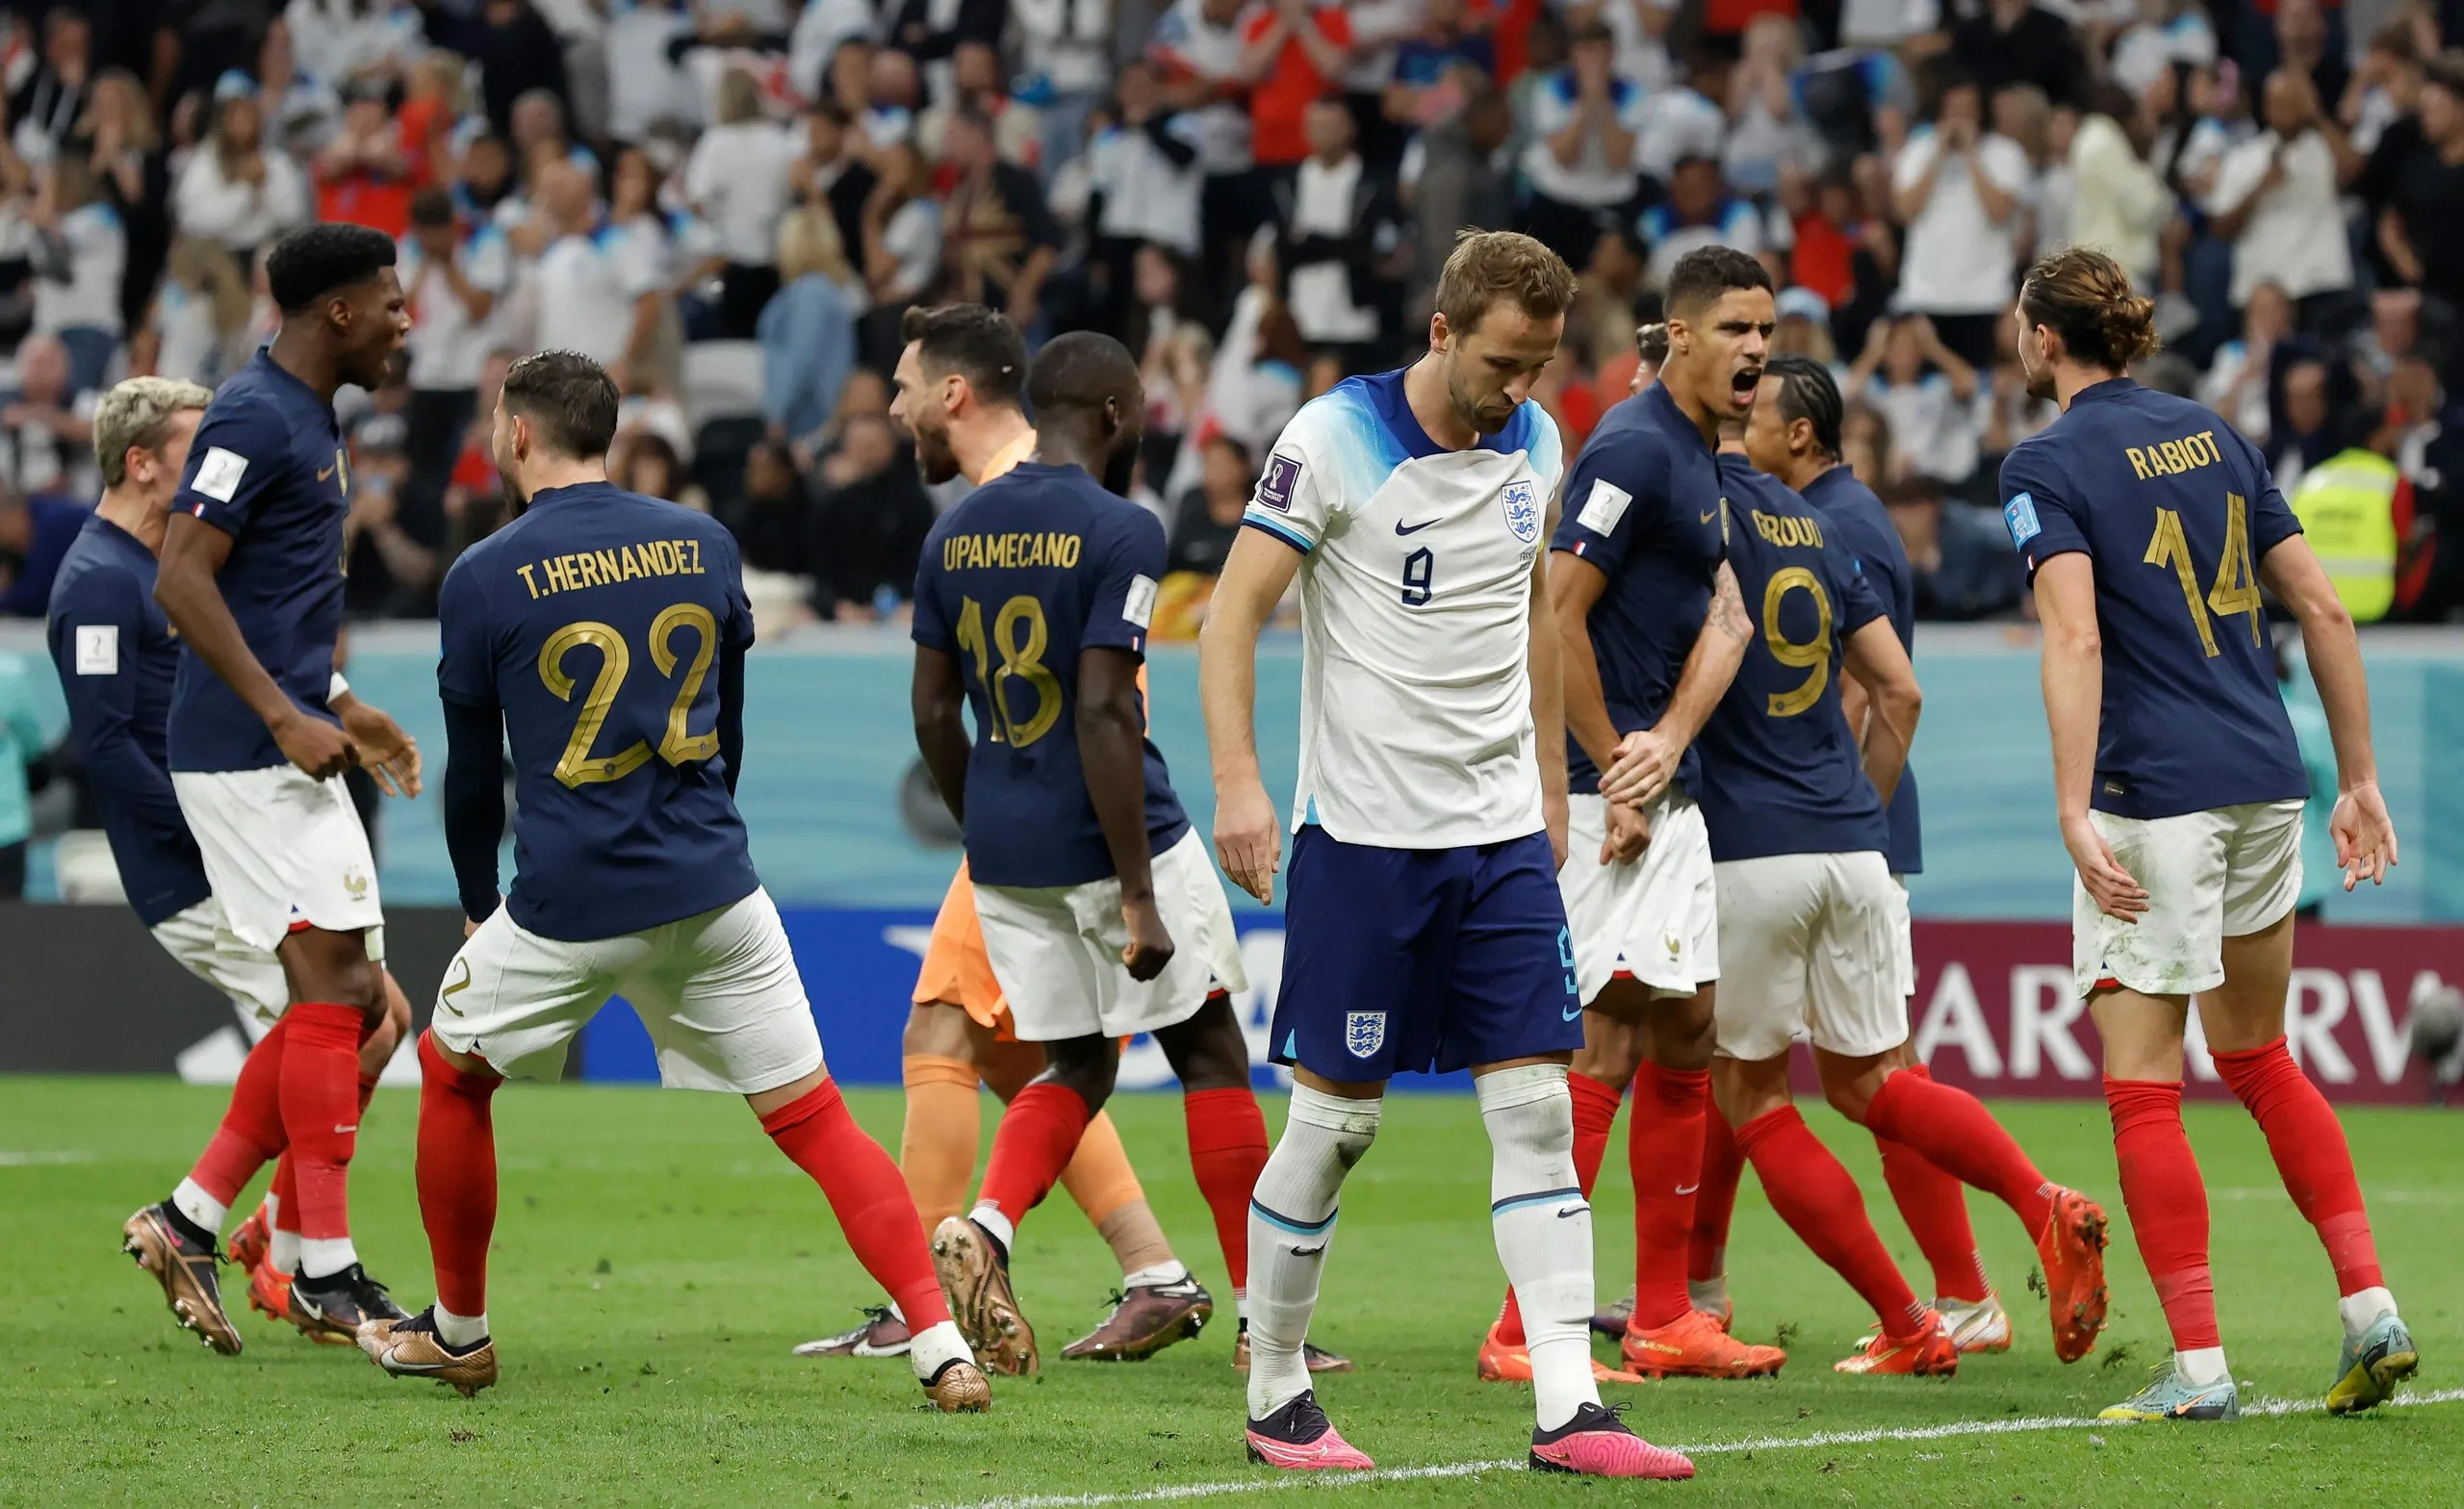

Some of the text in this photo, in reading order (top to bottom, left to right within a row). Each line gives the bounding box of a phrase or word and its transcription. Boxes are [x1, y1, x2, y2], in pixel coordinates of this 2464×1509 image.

[2124, 429, 2221, 479] RABIOT
[517, 539, 706, 600] T.HERNANDEZ
[943, 531, 1082, 571] UPAMECANO
[1401, 546, 1434, 606] 9
[2143, 491, 2265, 658] 14
[956, 594, 1063, 749] 18
[1762, 566, 1834, 718] 9
[537, 602, 721, 789] 22
